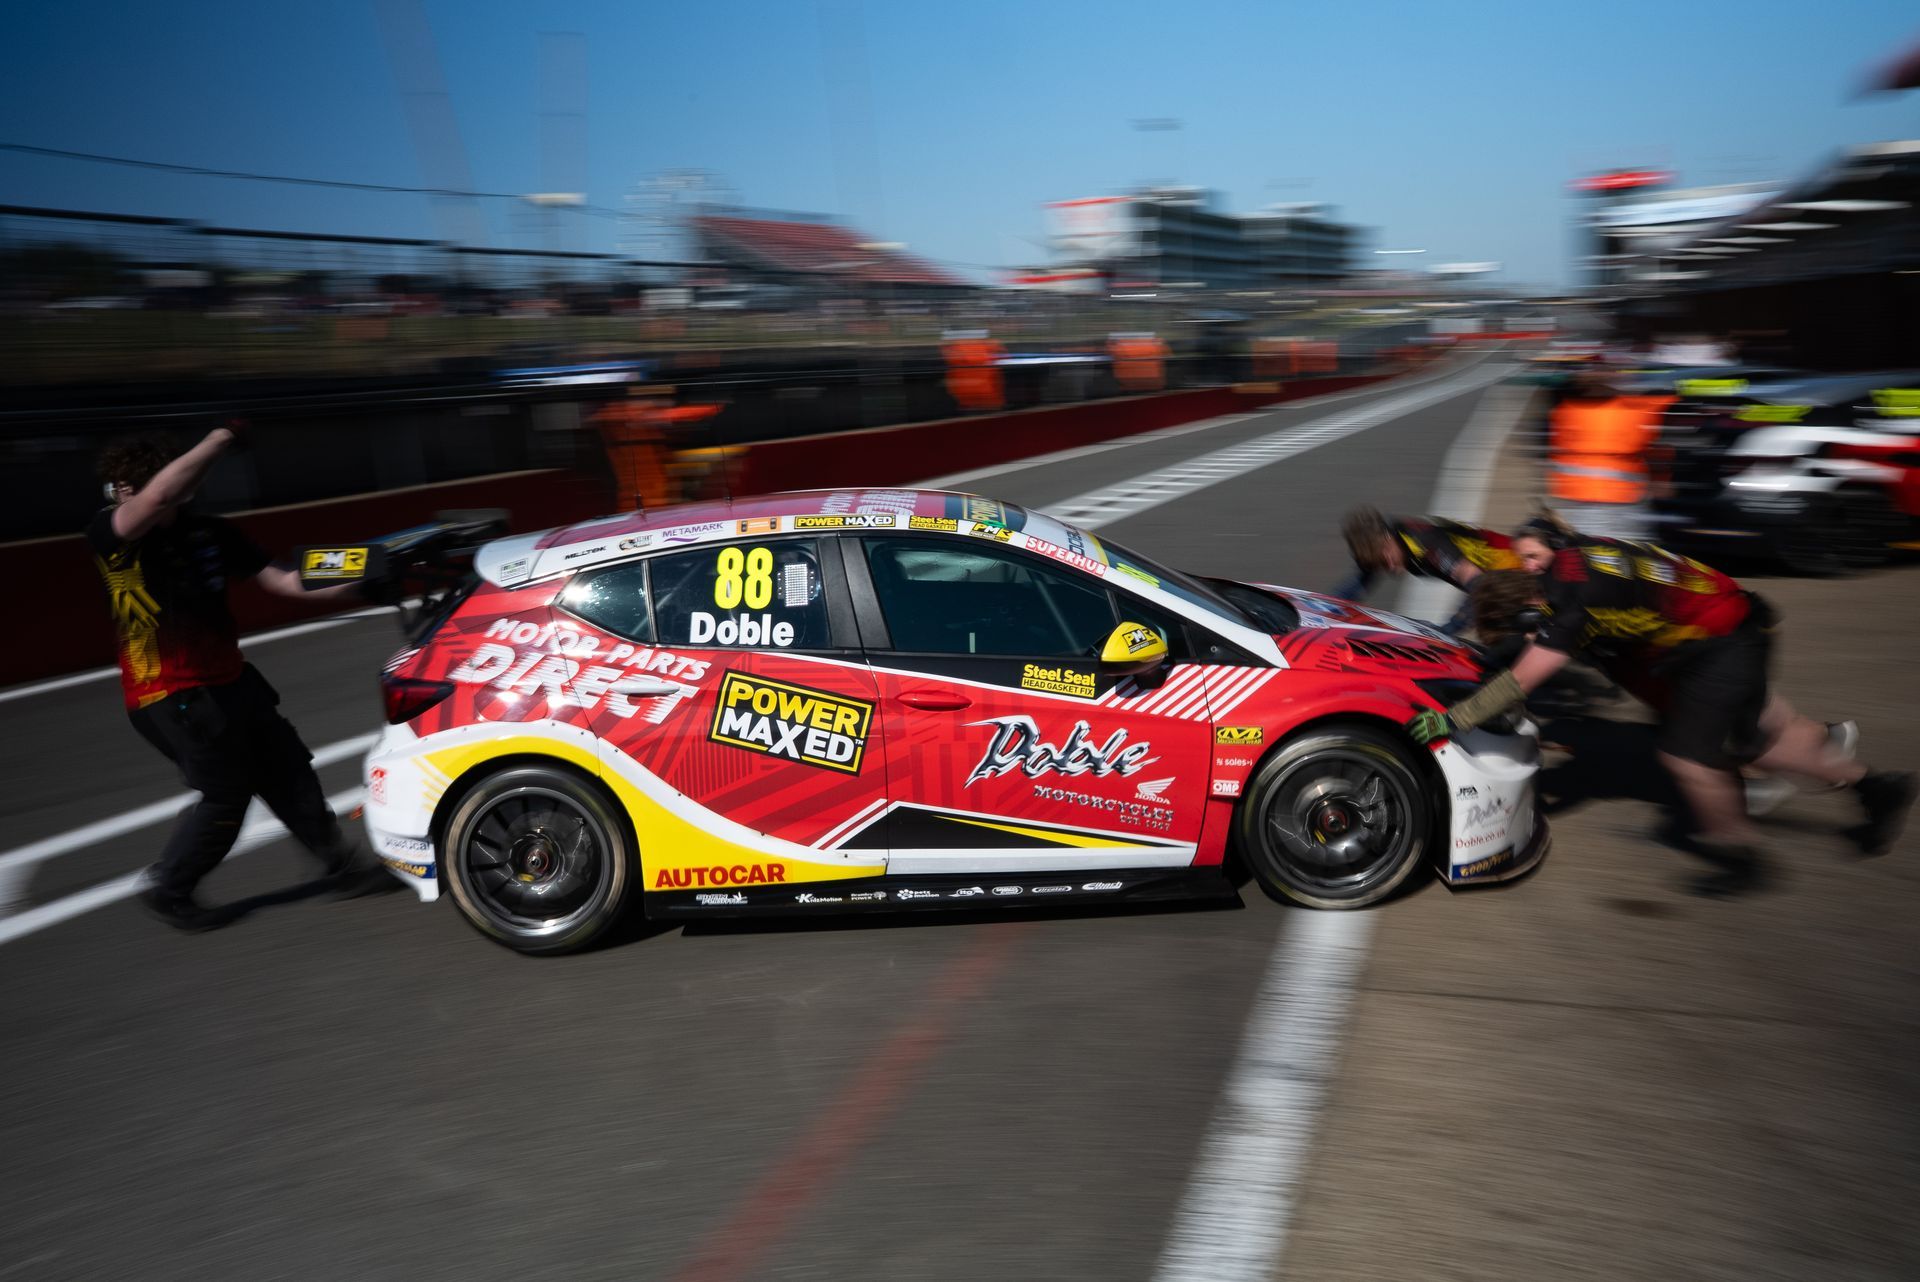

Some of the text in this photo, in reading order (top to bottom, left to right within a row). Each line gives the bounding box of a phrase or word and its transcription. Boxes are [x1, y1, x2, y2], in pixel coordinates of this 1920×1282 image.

[662, 522, 723, 538] METAMARK
[797, 515, 892, 527] POWER MAXED
[911, 515, 935, 524] Steel
[974, 523, 1014, 539] PMR
[305, 552, 364, 570] PMR
[1027, 537, 1106, 576] SUPERHUB
[714, 547, 774, 610] 88
[690, 612, 794, 646] Doble
[1122, 627, 1154, 647] PMR
[484, 618, 712, 681] MOTOR PARTS
[446, 642, 700, 725] DIRECT
[1023, 663, 1096, 687] Steel Seal
[1023, 678, 1093, 696] HEAD GASKET FIX
[727, 680, 860, 737] POWER
[963, 715, 1162, 790] Doble
[1134, 792, 1171, 806] HONDA
[1213, 781, 1240, 794] OMP
[1033, 784, 1175, 822] MOTORCYCLES
[655, 863, 786, 889] AUTOCAR
